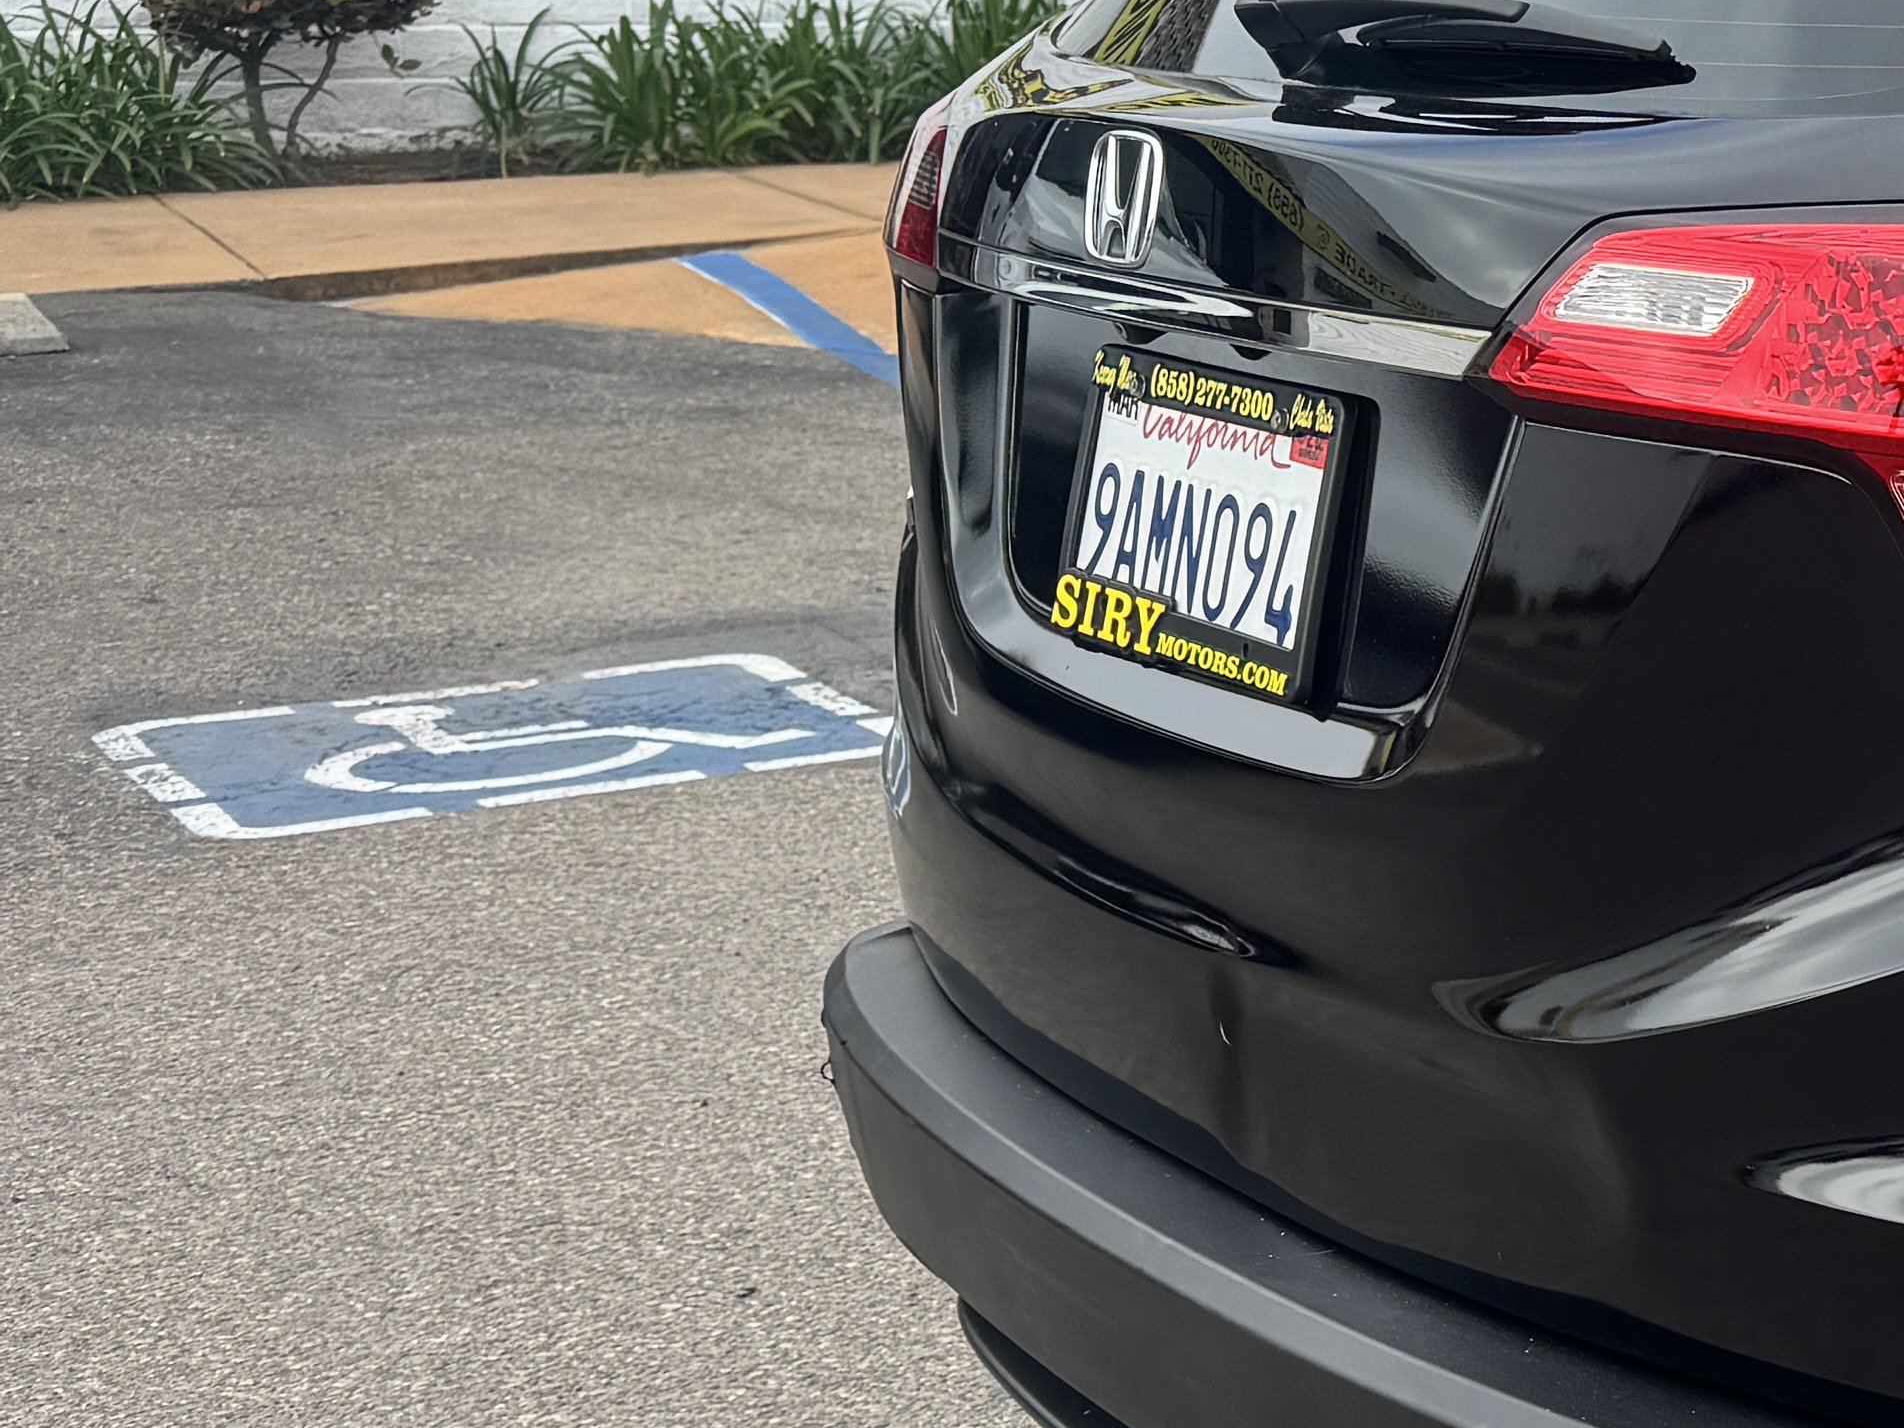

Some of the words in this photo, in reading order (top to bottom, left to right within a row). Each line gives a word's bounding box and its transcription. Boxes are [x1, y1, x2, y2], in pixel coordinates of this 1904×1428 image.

[1142, 404, 1292, 470] California
[1085, 462, 1297, 646] 9AMN094
[1050, 573, 1166, 656] SIRY
[1156, 632, 1289, 697] MOTORS.COM
